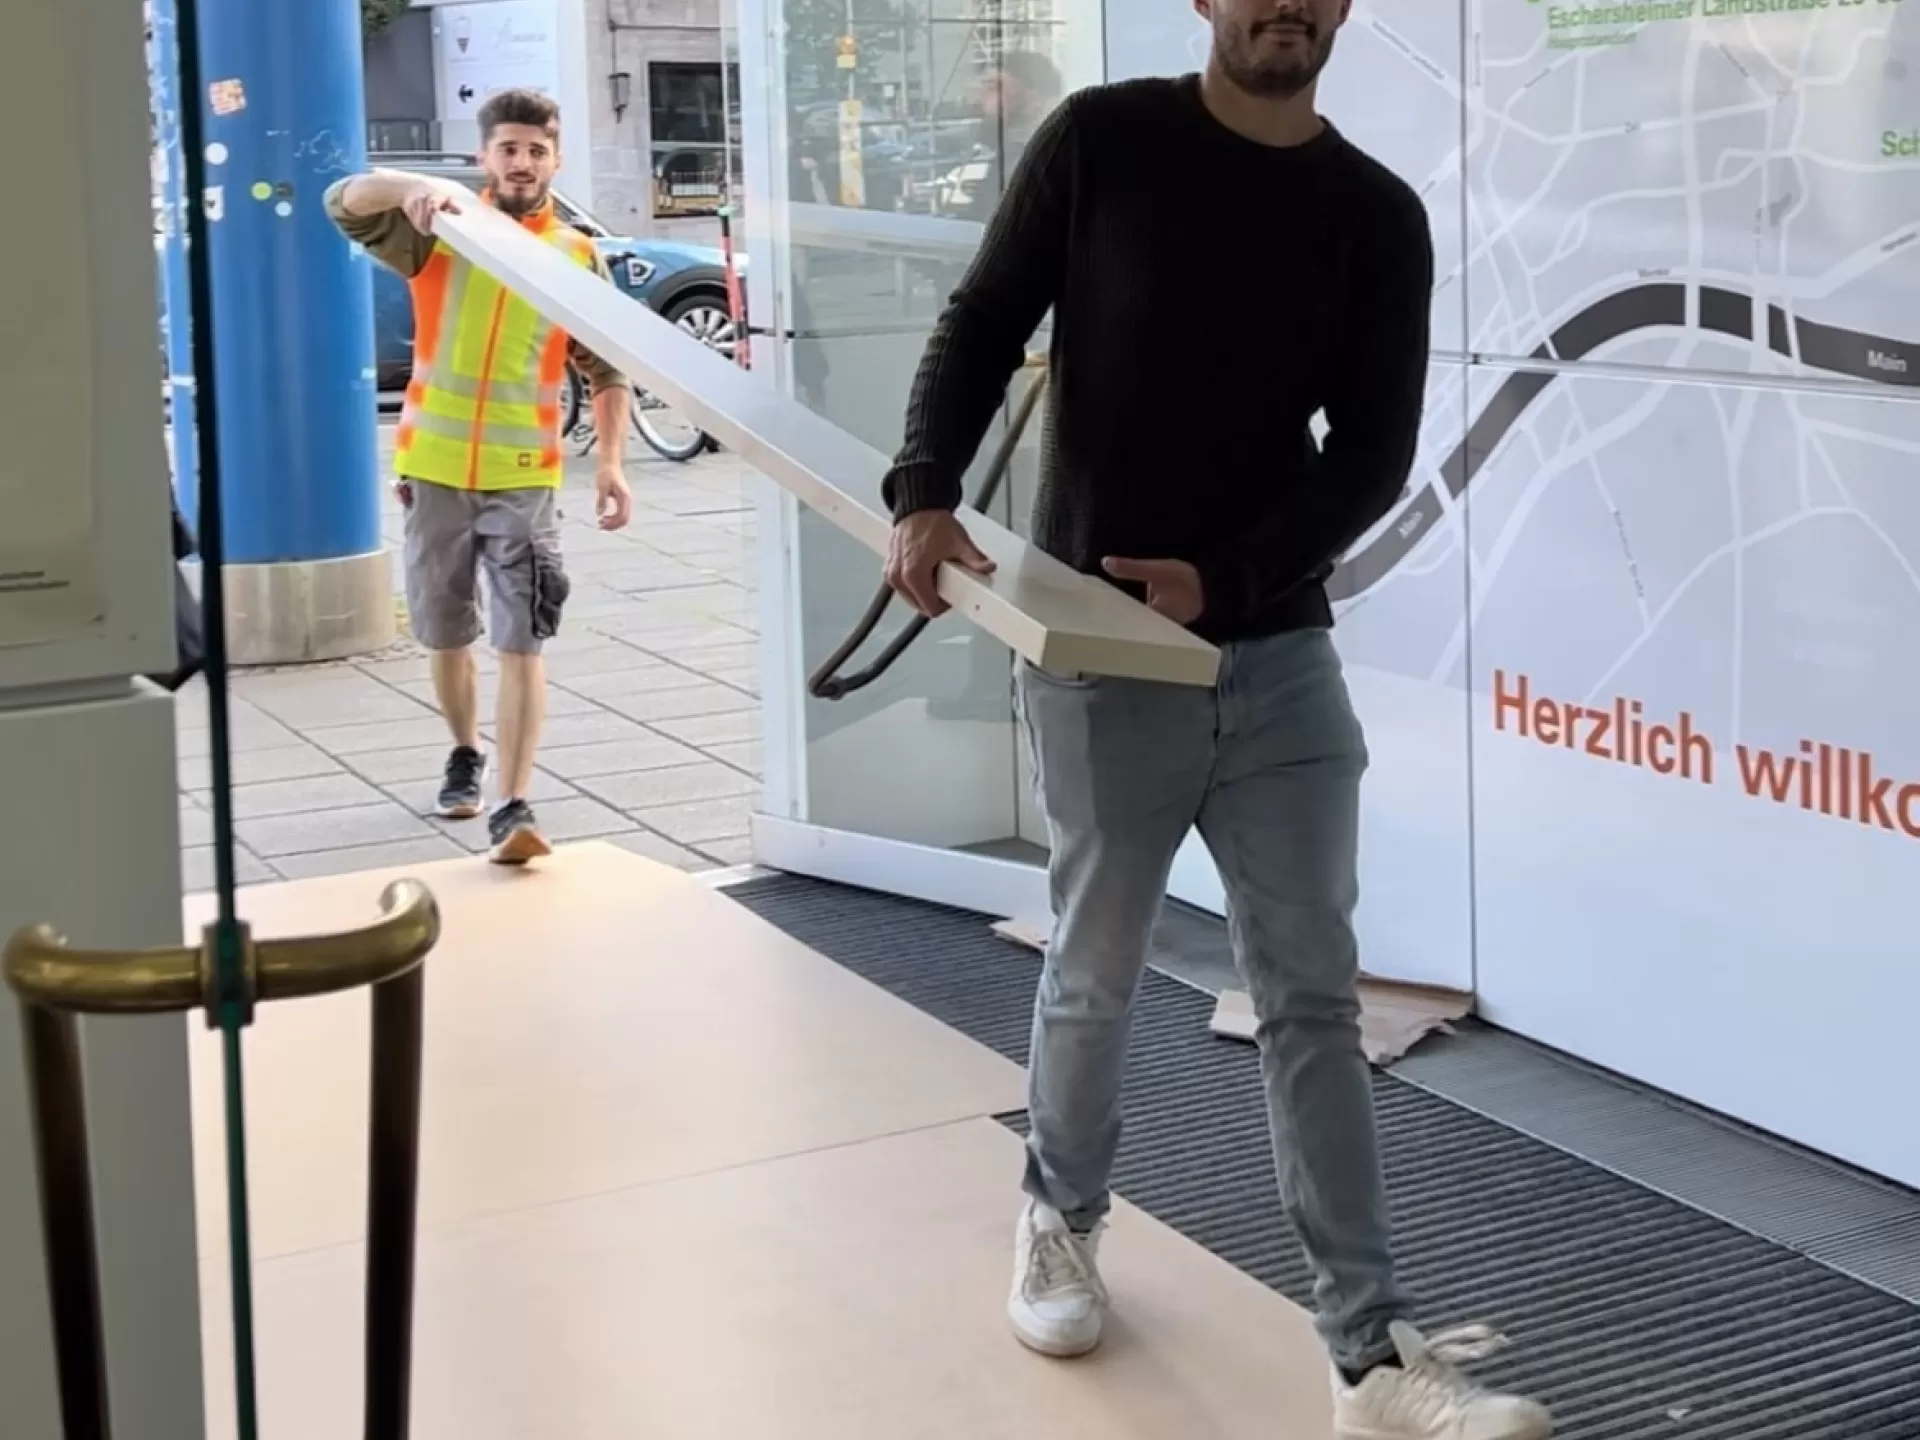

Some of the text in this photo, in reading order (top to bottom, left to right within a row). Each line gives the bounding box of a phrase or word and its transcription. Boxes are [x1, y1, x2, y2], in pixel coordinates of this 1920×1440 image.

[1548, 2, 1694, 29] Eschersheimer
[1867, 349, 1907, 373] Main
[1493, 668, 1920, 839] Herzlich willko
